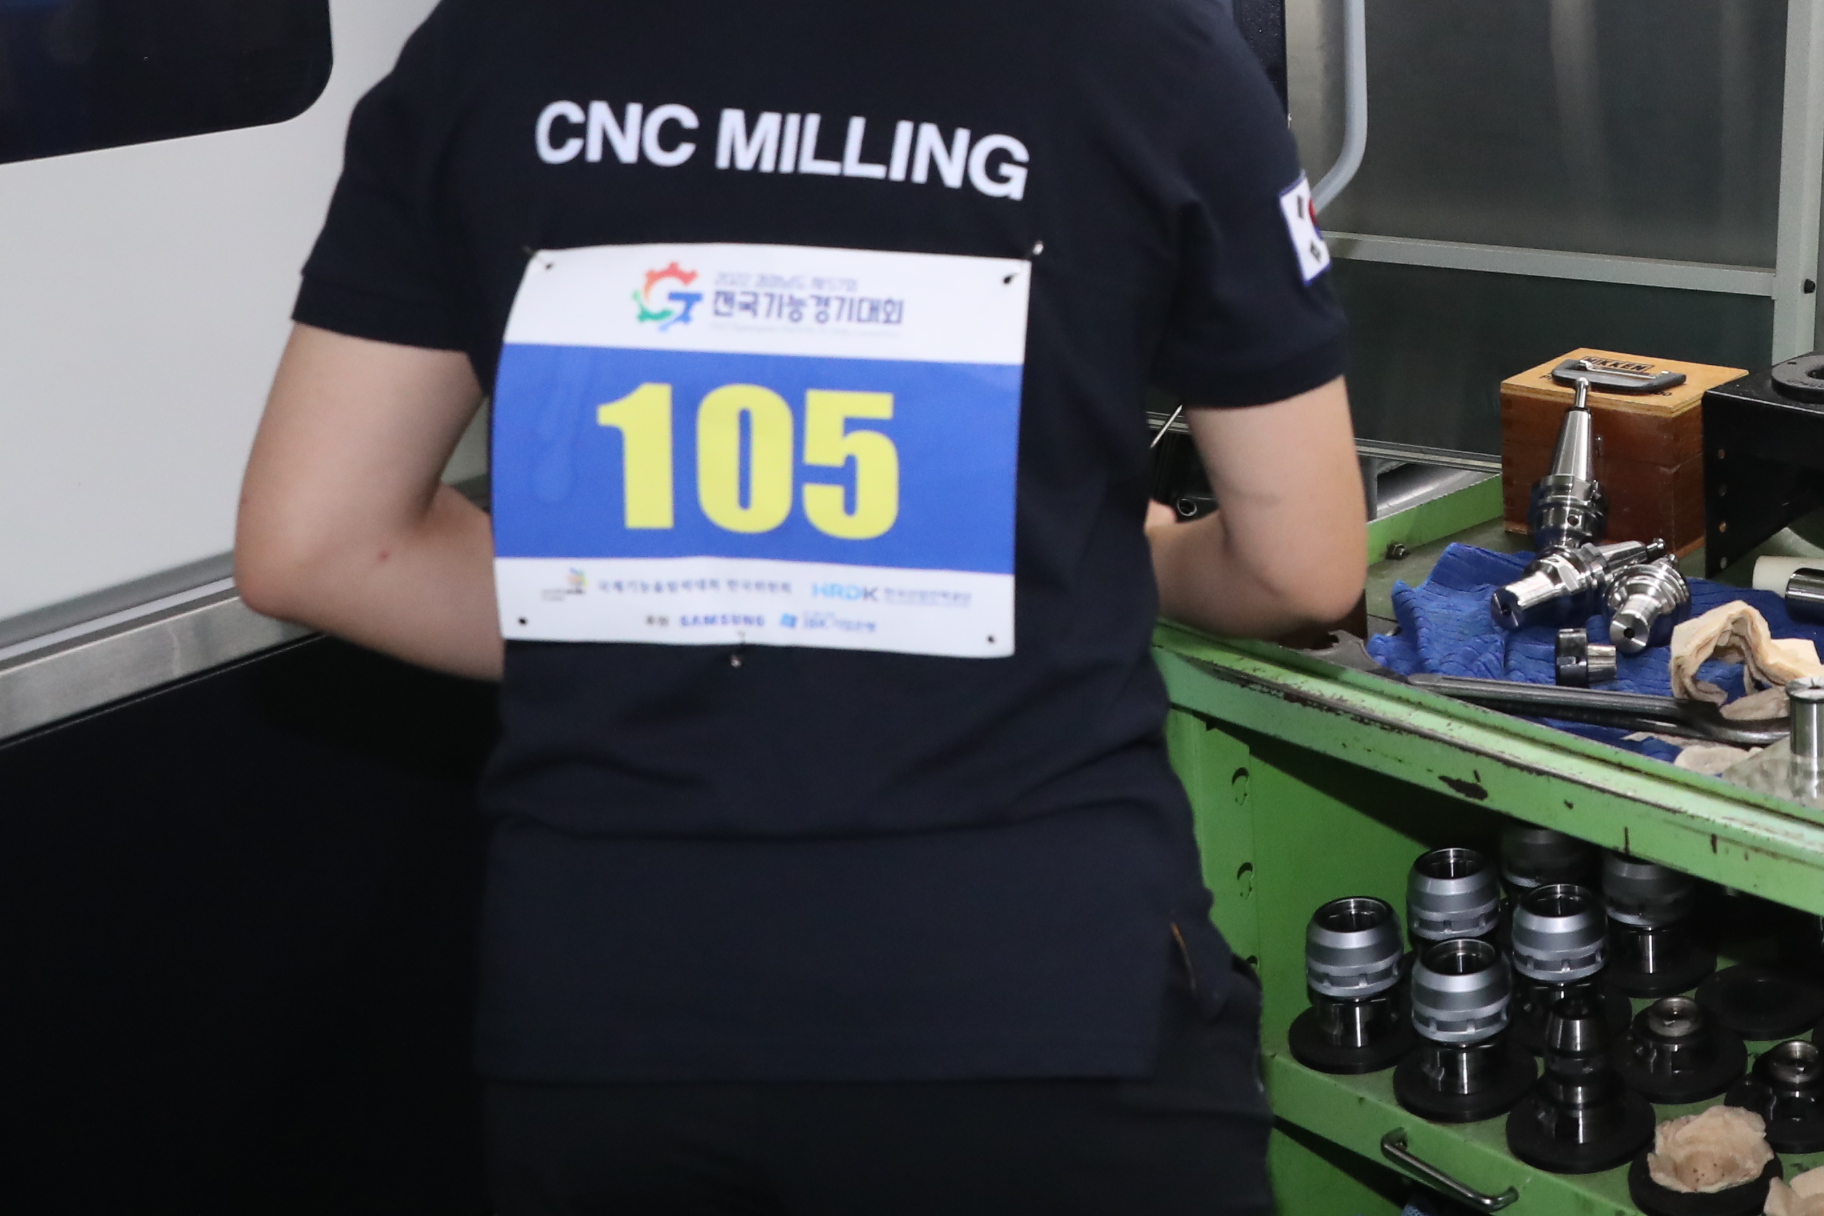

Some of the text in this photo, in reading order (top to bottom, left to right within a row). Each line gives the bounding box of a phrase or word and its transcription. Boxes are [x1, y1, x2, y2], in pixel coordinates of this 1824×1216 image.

[535, 99, 1030, 201] CNC MILLING
[713, 289, 904, 325] 전국기능경기대회
[596, 382, 900, 541] 105
[680, 612, 766, 628] SAMSUNG
